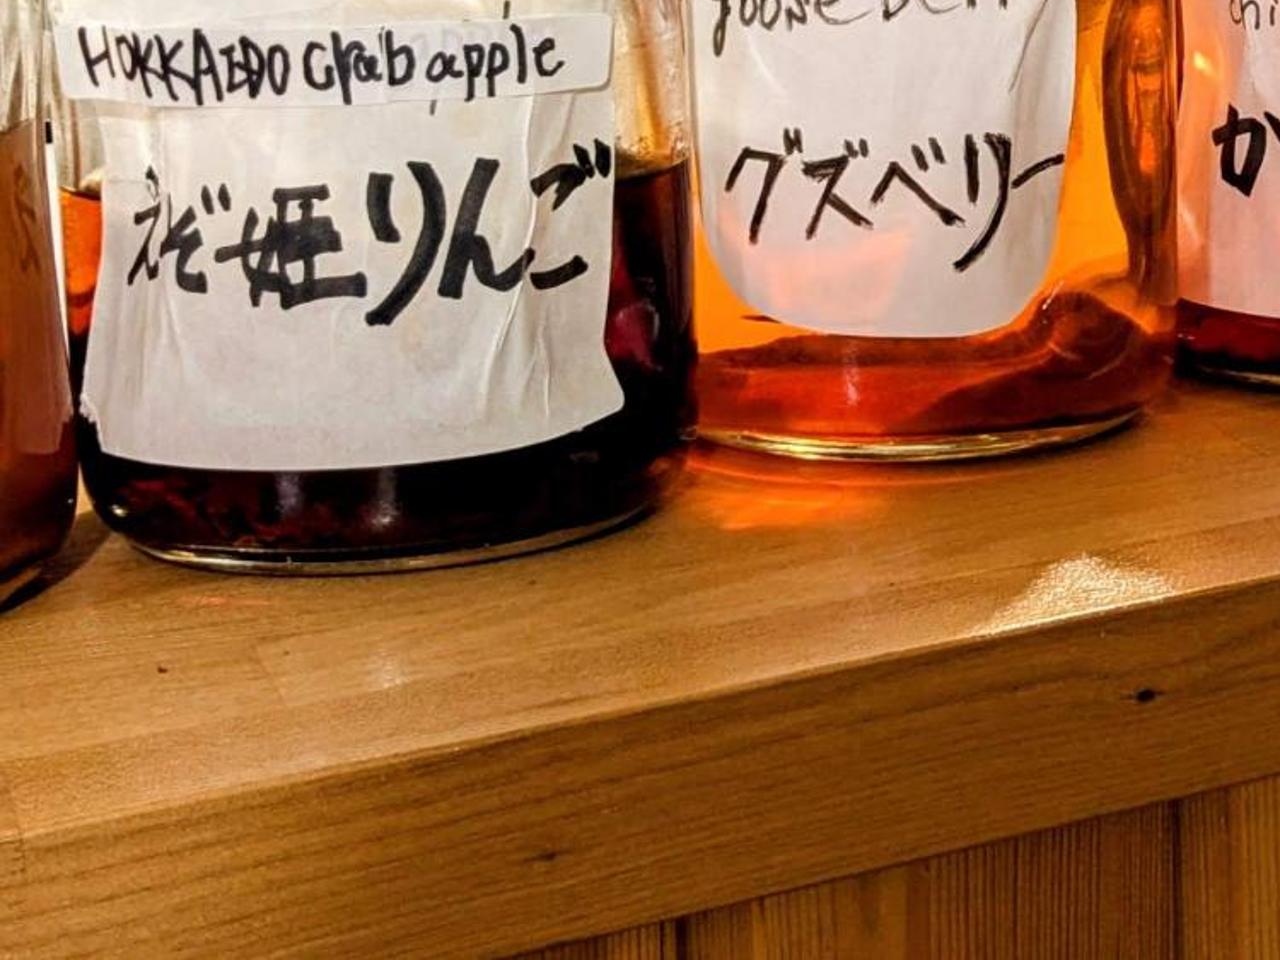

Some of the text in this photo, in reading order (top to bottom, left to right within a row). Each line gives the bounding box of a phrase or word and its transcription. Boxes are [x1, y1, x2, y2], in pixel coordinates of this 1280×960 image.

[425, 22, 566, 104] apple
[724, 127, 1066, 273] グズベリー
